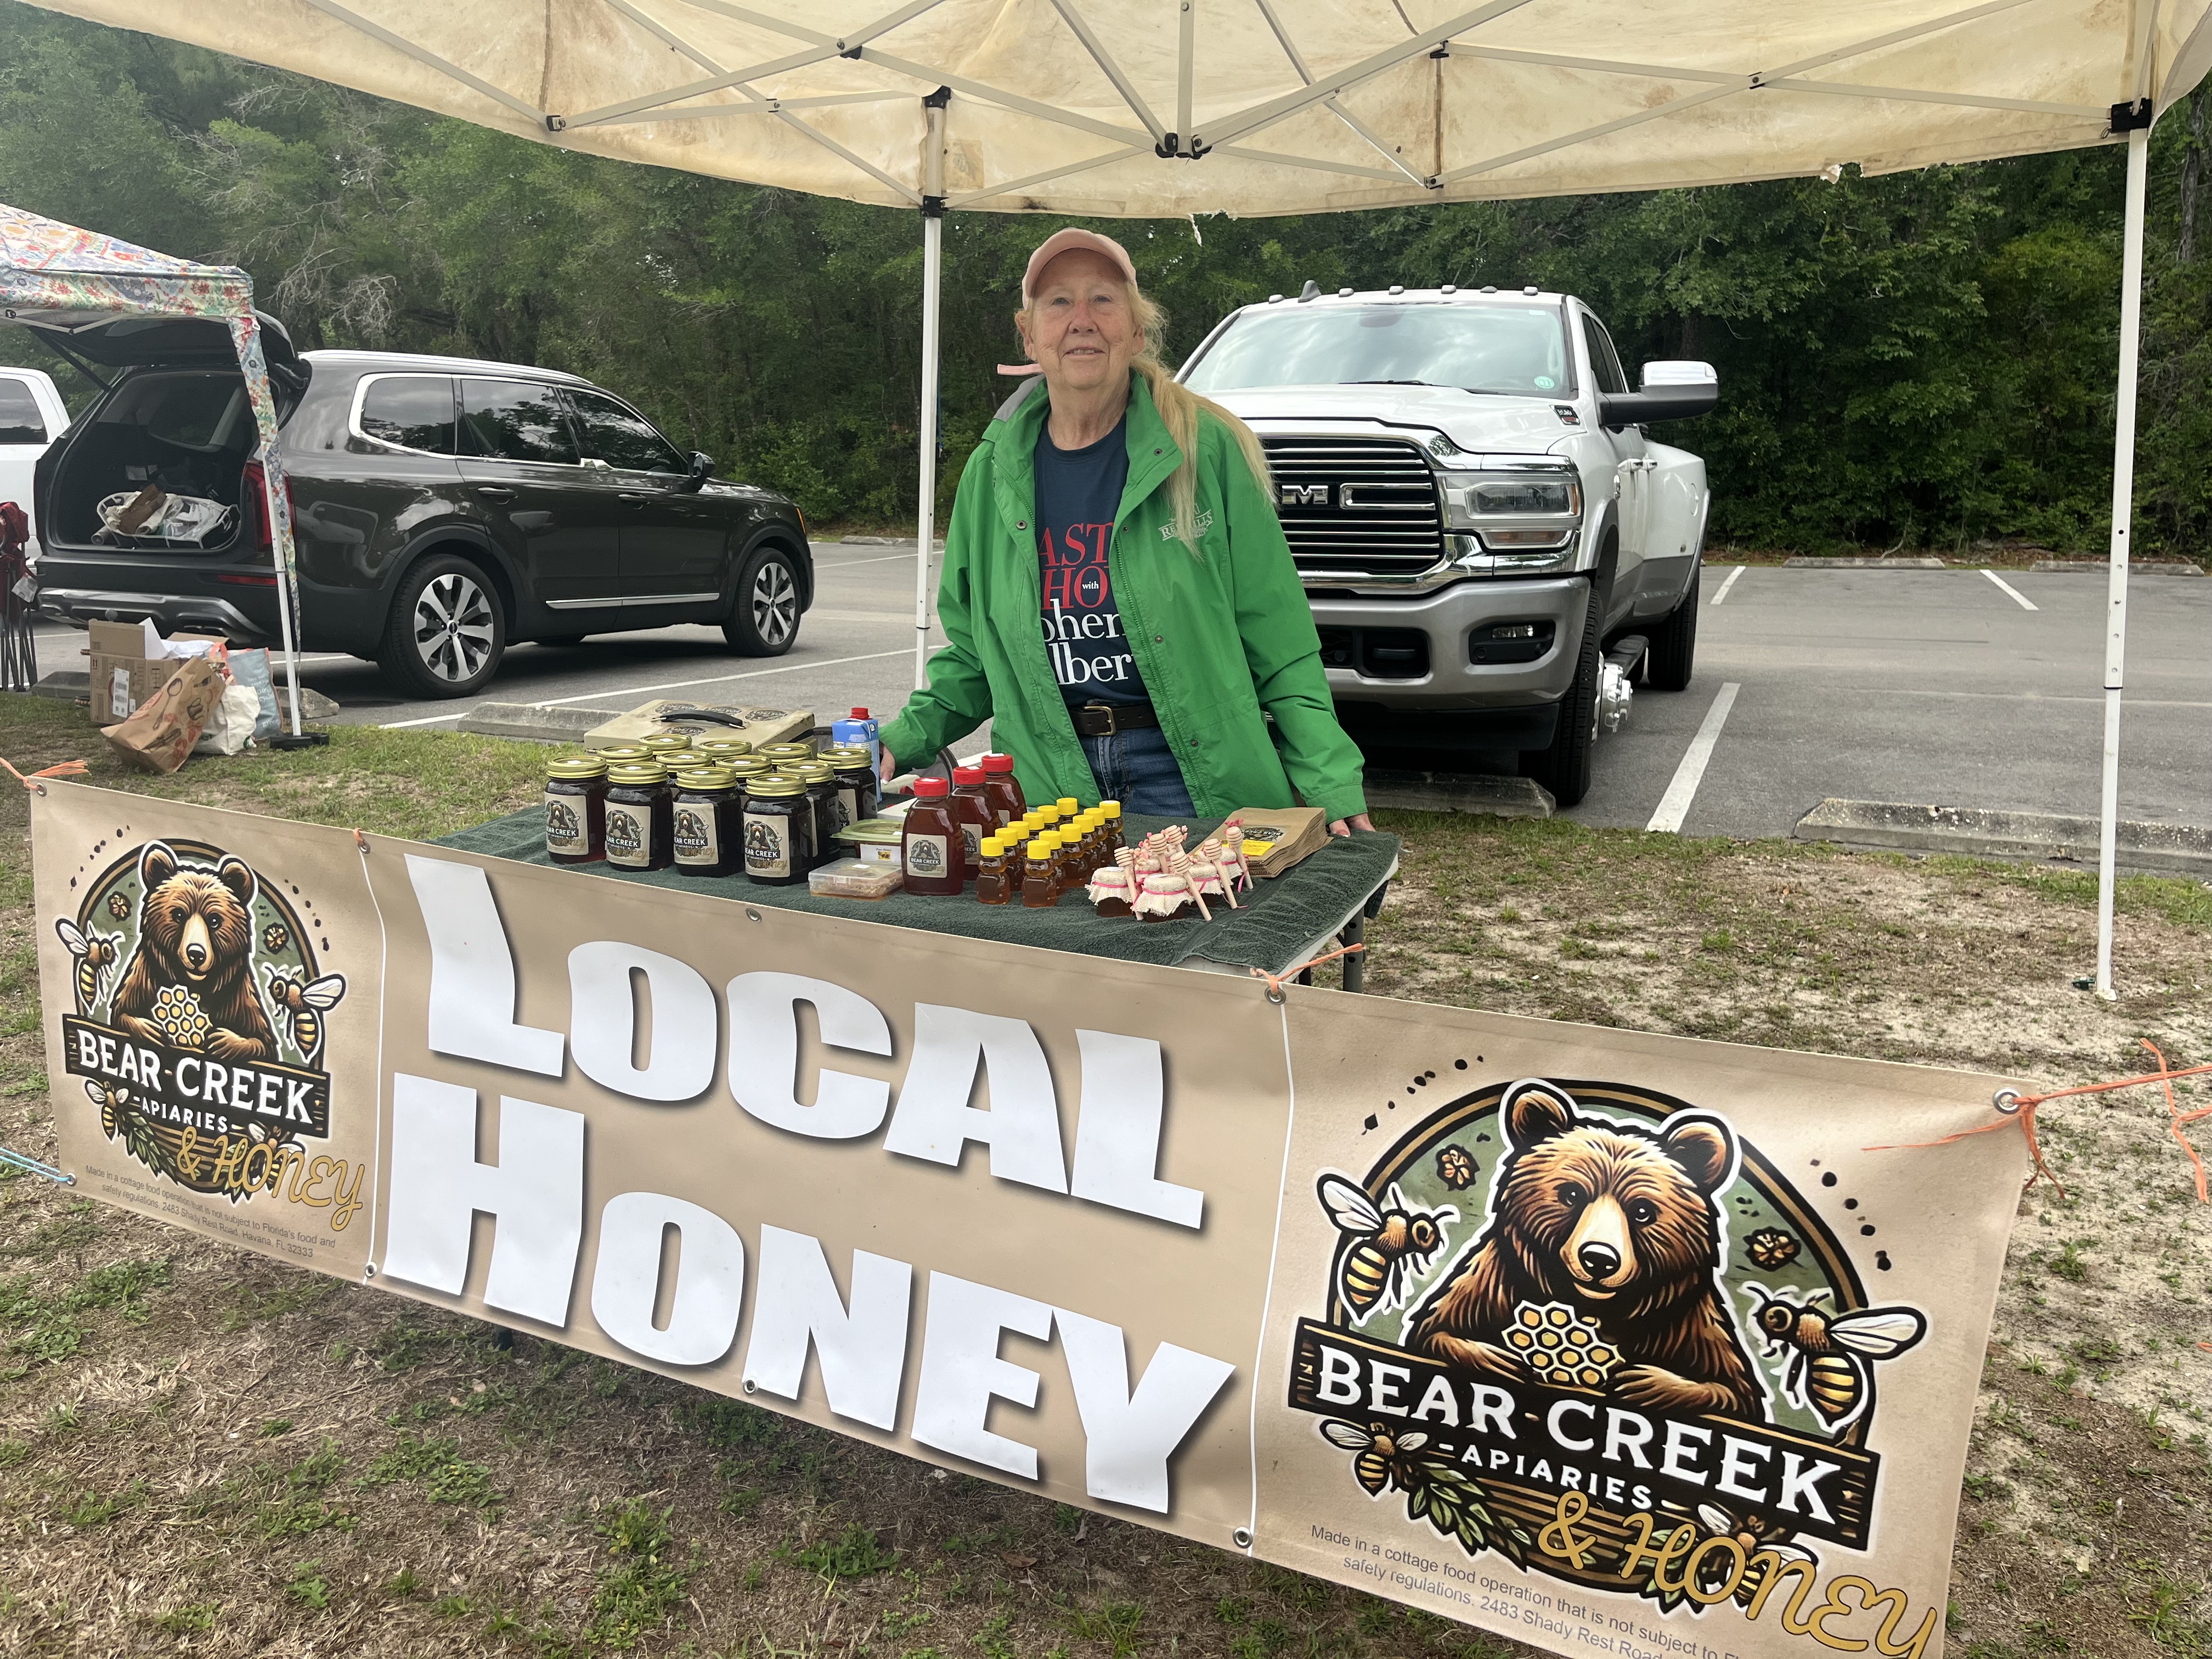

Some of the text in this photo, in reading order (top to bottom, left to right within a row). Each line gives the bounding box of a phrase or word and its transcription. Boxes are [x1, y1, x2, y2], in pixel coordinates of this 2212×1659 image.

[1041, 566, 1109, 610] HO
[1082, 581, 1099, 590] with
[1048, 641, 1133, 685] lber
[555, 828, 577, 836] CREEK
[606, 835, 638, 848] EAR CREEK
[755, 850, 778, 858] CREEK
[76, 1029, 314, 1124] BEAR CREEK
[404, 853, 1204, 1230] LOCAL
[141, 1099, 229, 1133] APIARIES
[86, 1165, 105, 1178] Made
[107, 1170, 113, 1180] in
[120, 1176, 145, 1190] cottage
[146, 1182, 160, 1195] food
[162, 1189, 190, 1205] operation
[191, 1200, 204, 1212] that
[205, 1205, 211, 1215] is
[212, 1209, 223, 1219] not
[225, 1212, 251, 1228] subject
[252, 1221, 261, 1230] to
[263, 1223, 295, 1239] Florida's
[297, 1232, 318, 1244] food
[320, 1237, 336, 1249] and
[177, 1126, 365, 1232] & HONEY
[102, 1183, 313, 1258] safety regulations. 2483 Shady Rest Road, Havana, FL 32333
[382, 1072, 1237, 1515] HONEY
[1315, 1343, 1843, 1527] BEAR CREEK
[1460, 1444, 1652, 1509] APIARIES
[1311, 1525, 1718, 1659] Made in a cottage food operation that is not subject to
[1343, 1556, 1387, 1581] safety
[1390, 1570, 1475, 1607] regulations.
[1480, 1595, 1518, 1620] 2483
[1522, 1610, 1573, 1640] Shady
[1577, 1626, 1615, 1652] Rest
[1537, 1491, 1937, 1659] & HONEY
